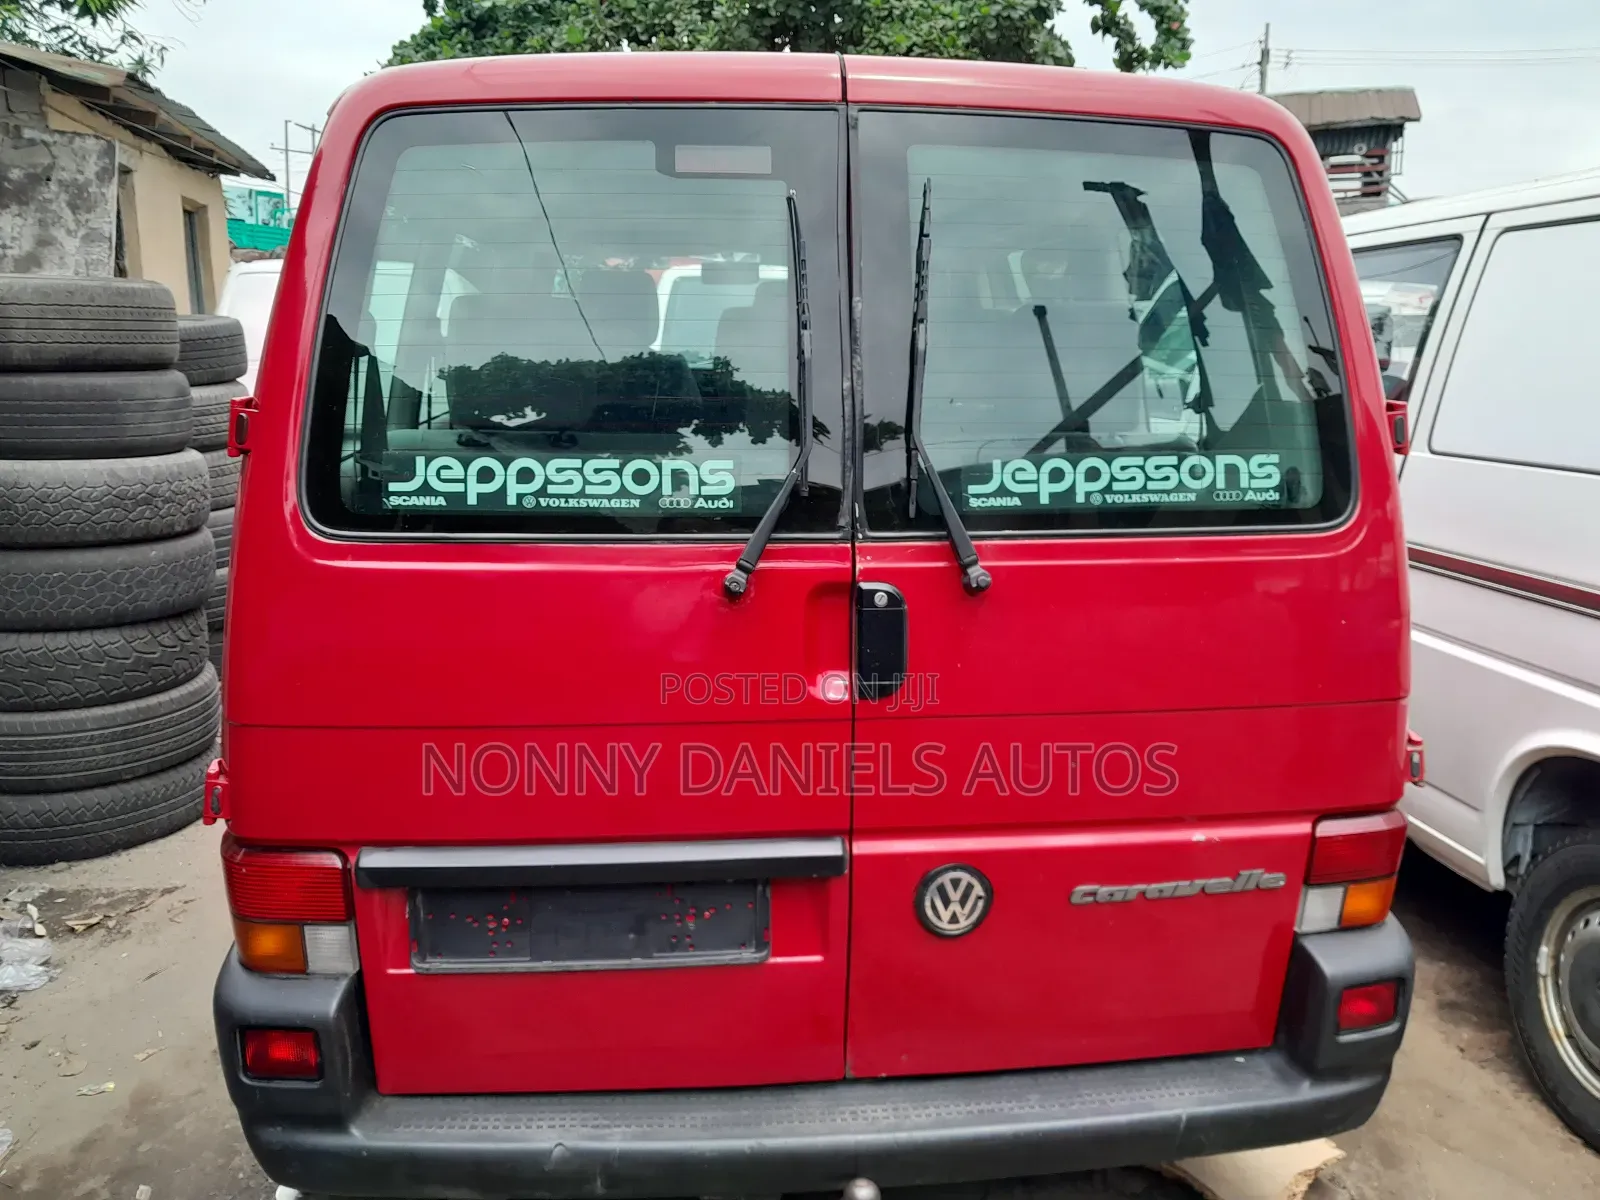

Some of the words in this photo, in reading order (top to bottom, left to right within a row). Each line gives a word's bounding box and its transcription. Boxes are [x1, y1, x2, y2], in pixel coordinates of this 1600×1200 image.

[389, 495, 447, 506] SCANIA
[538, 498, 641, 508] VOLKSWAGEN
[694, 497, 734, 509] Audi
[968, 496, 1022, 507] SCANIA
[1104, 492, 1197, 504] VOLKSWAGEN
[1243, 489, 1280, 502] Audi
